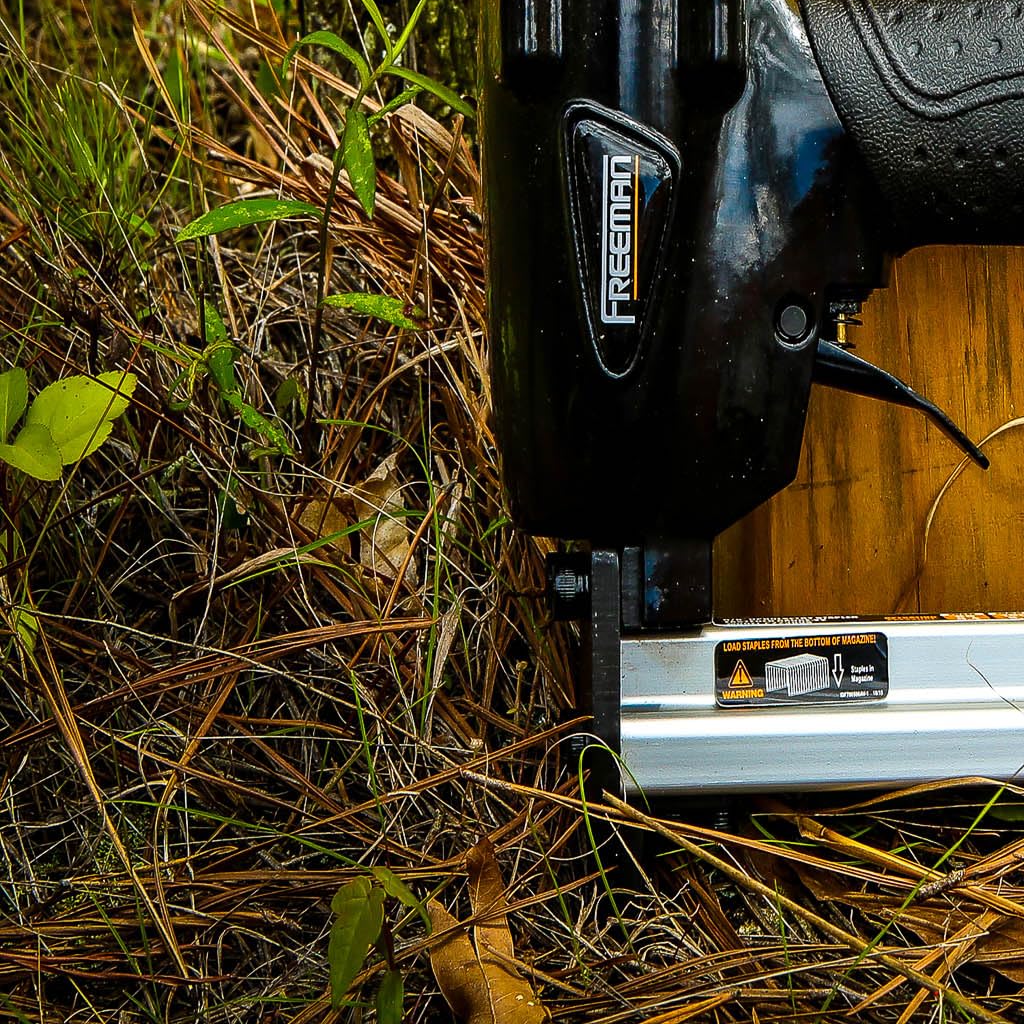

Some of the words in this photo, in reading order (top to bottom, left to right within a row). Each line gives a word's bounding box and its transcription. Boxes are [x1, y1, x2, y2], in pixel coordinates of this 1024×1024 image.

[601, 155, 636, 323] FREEMAN
[723, 642, 742, 652] LOAD
[742, 640, 770, 651] STAPLES
[771, 639, 790, 649] FROM
[791, 638, 804, 648] THE
[804, 637, 831, 647] BOTTOM
[831, 636, 841, 646] OF
[841, 634, 877, 645] MAGAZINE!
[850, 665, 869, 675] Staples
[869, 664, 875, 673] in
[850, 675, 874, 684] Magazine
[722, 689, 765, 699] WARNING
